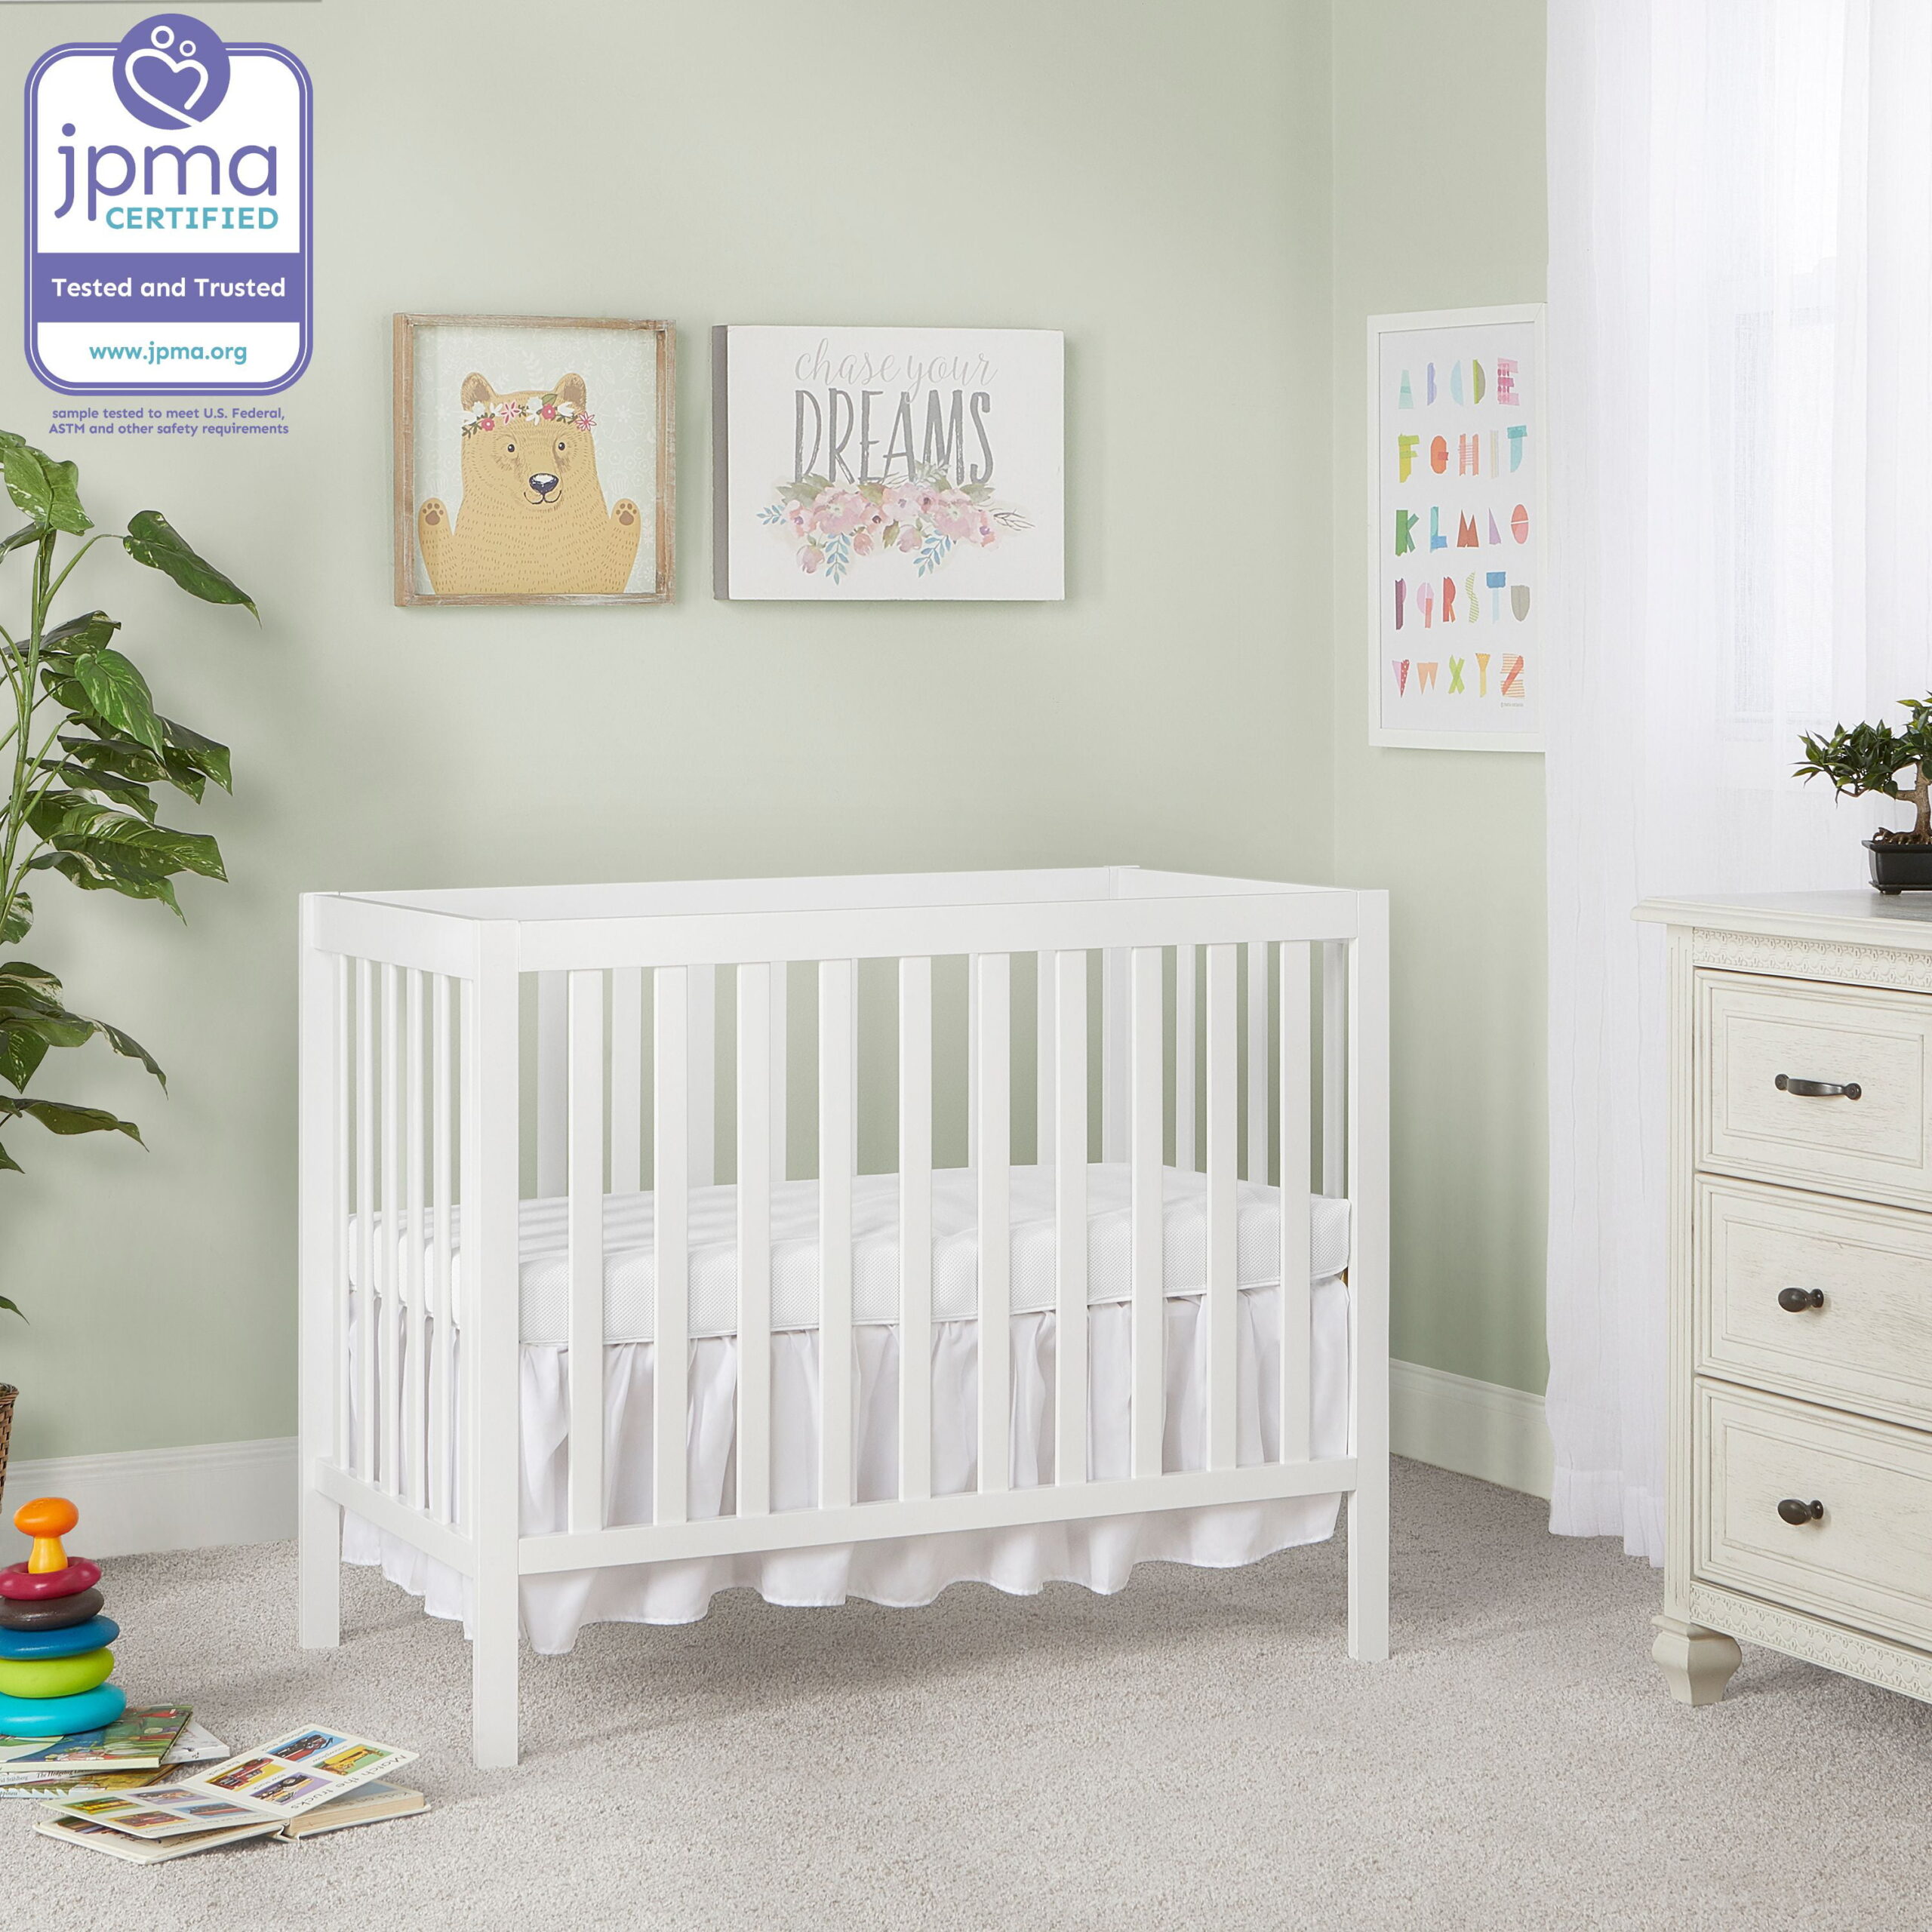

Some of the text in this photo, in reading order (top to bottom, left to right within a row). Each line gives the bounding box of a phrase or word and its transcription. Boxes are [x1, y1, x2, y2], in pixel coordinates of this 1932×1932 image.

[795, 337, 998, 404] chase your
[795, 388, 995, 485] DREAMS
[361, 1754, 407, 1777] Match
[336, 1776, 360, 1789] the
[291, 1788, 334, 1810] trucks
